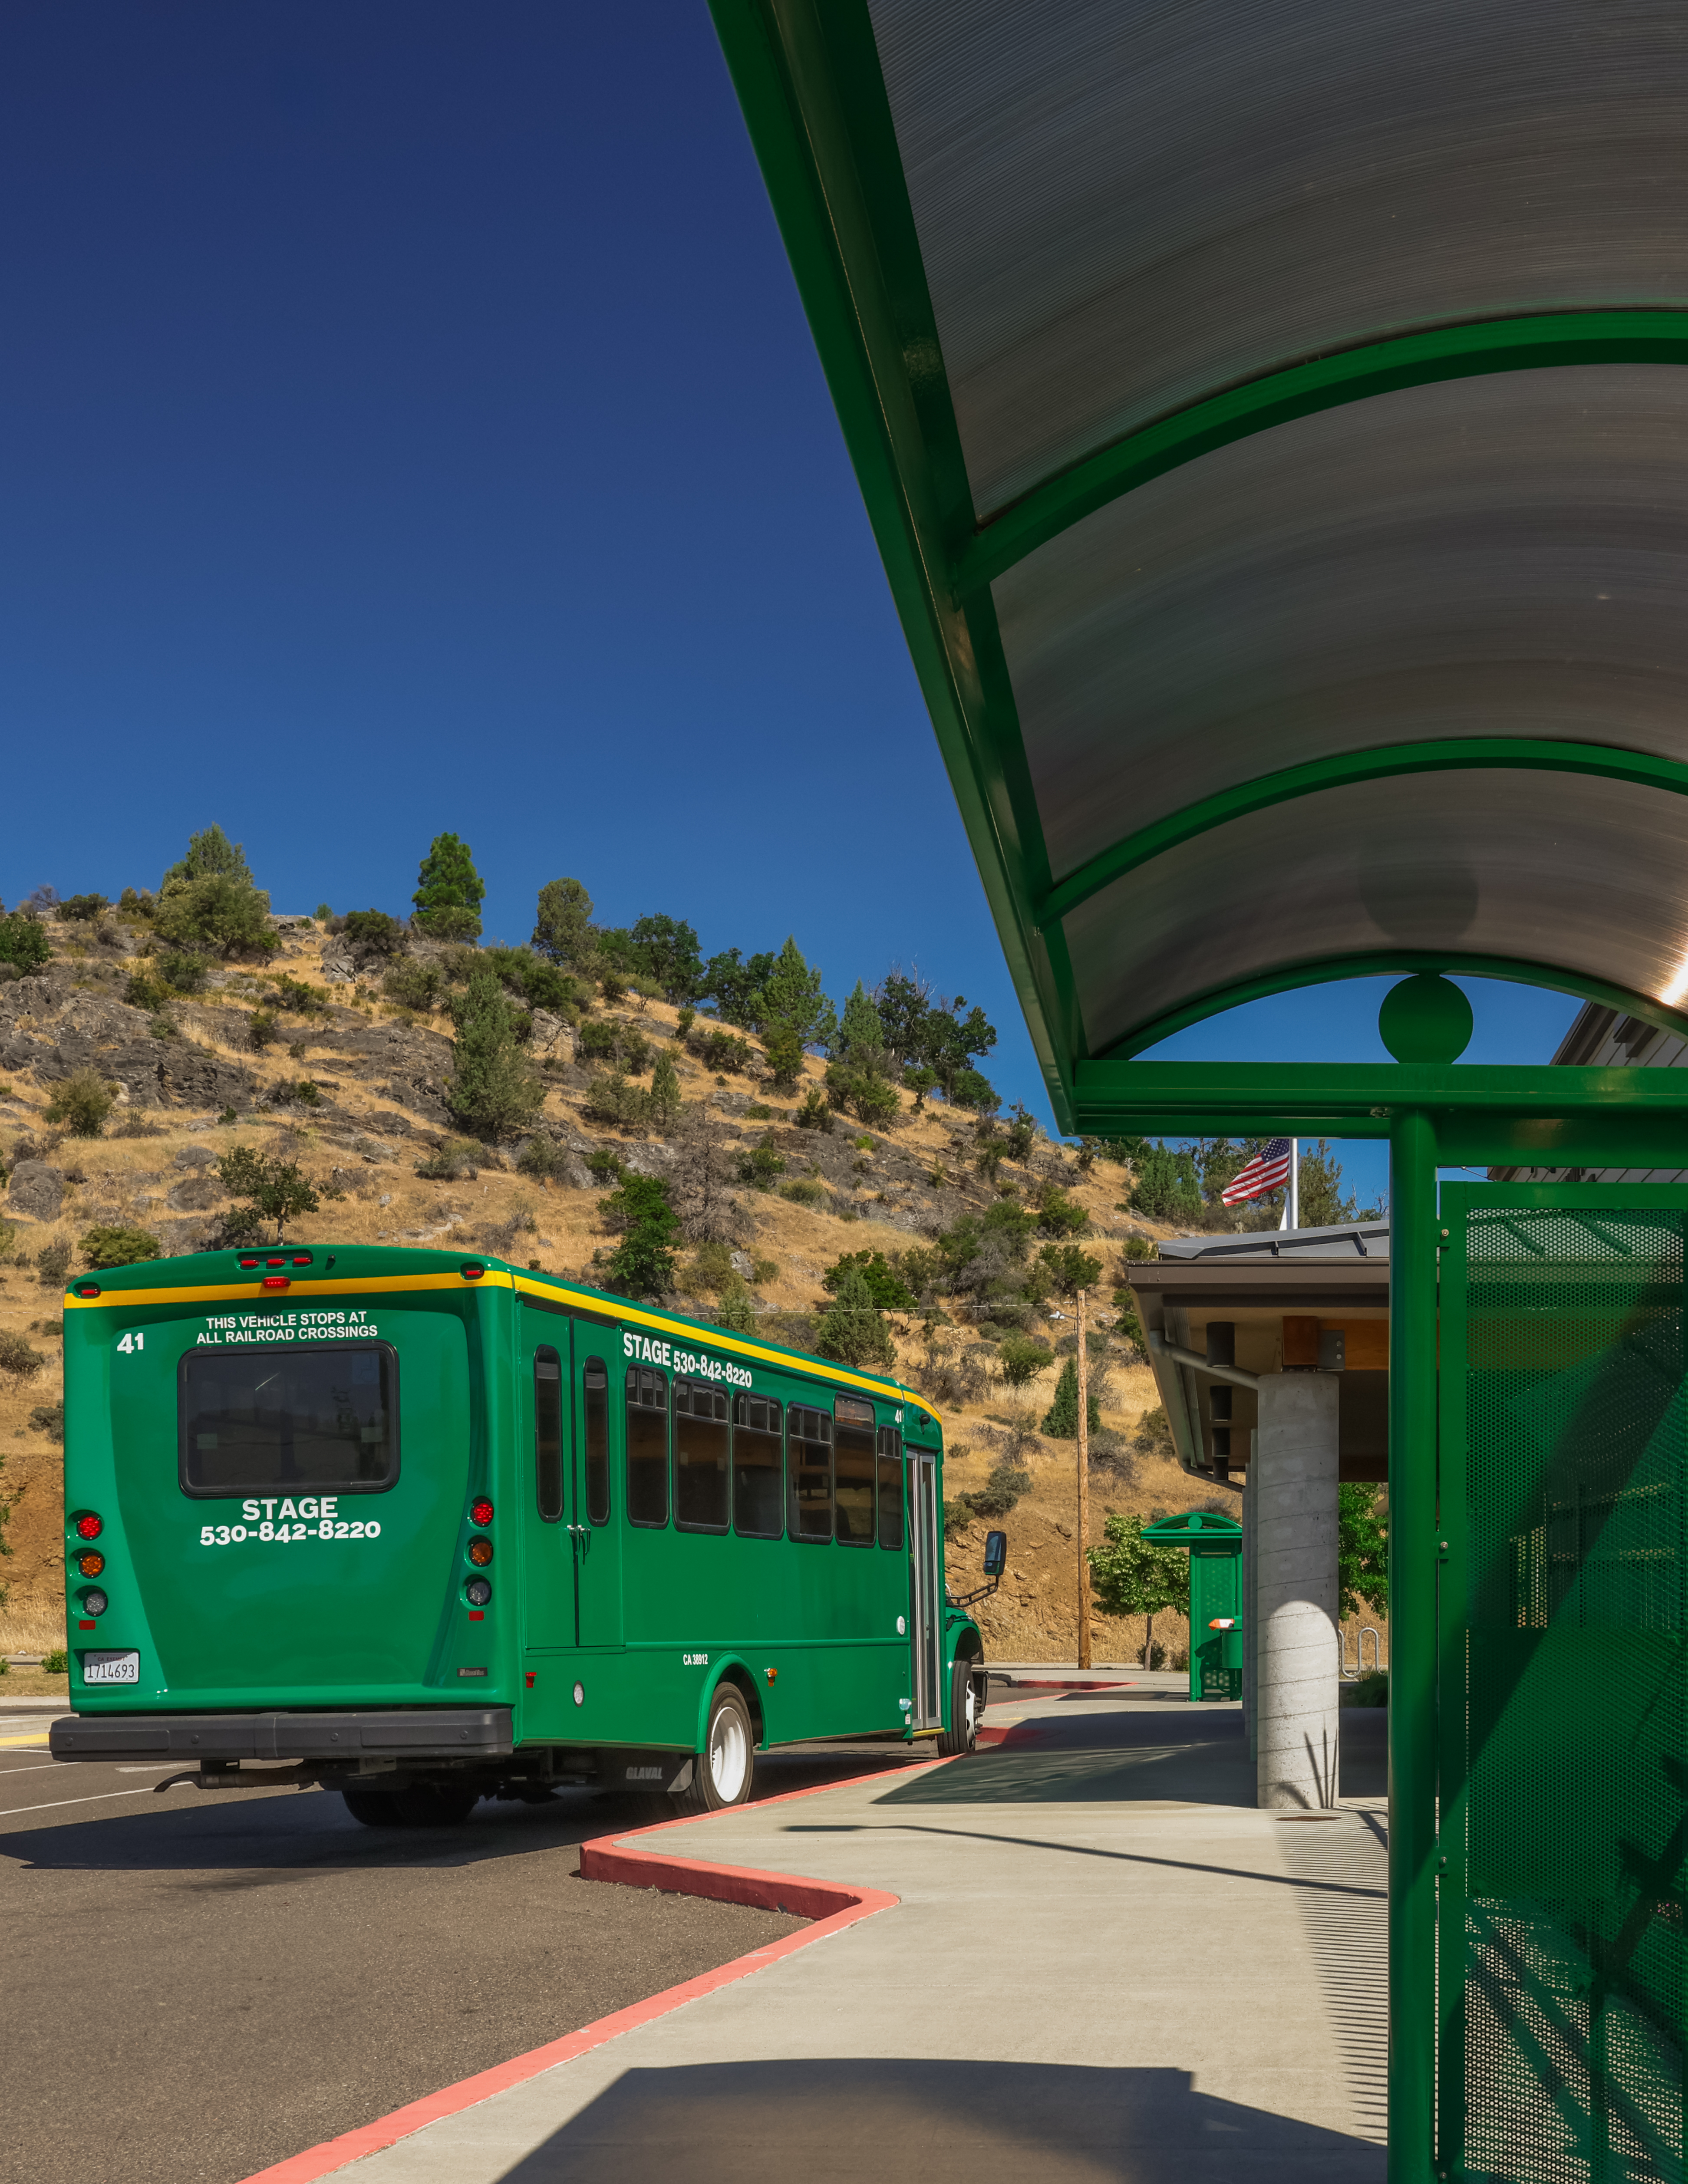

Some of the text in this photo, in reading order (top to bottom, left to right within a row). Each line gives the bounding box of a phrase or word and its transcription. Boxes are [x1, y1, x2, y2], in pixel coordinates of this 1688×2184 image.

[206, 1311, 367, 1329] THIS VEHICLE STOPS AT
[117, 1333, 144, 1354] 41
[197, 1325, 378, 1344] ALL RAILROAD CROSSINGS
[623, 1332, 752, 1388] STAGE 530-842-8220
[895, 1410, 902, 1423] 41
[242, 1497, 338, 1520] STAGE
[200, 1520, 381, 1545] 530-842-8220
[683, 1653, 708, 1665] CA 38912
[88, 1664, 134, 1678] 1714693
[626, 1767, 662, 1779] GLAVAL
